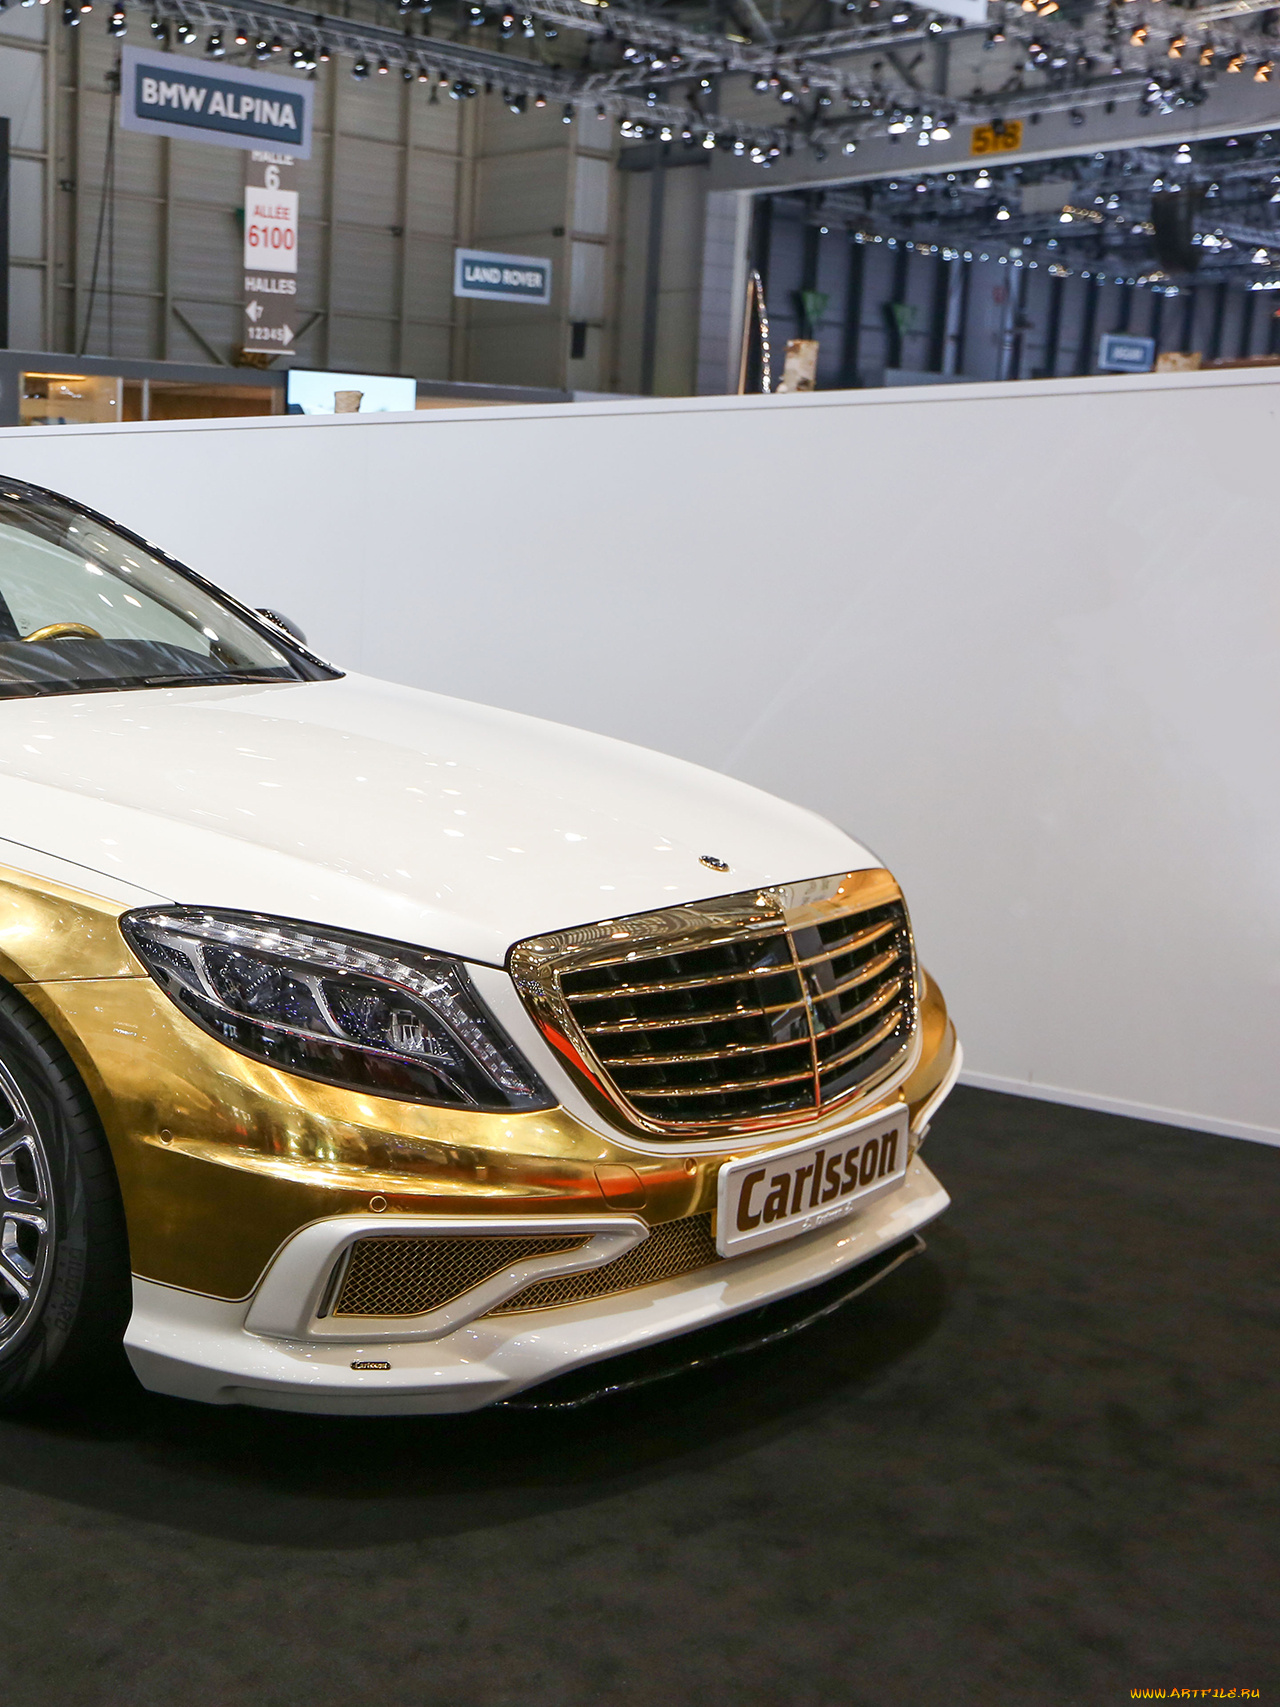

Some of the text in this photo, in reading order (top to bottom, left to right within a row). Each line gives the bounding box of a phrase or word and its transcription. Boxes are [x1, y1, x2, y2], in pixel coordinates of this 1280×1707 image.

[141, 77, 297, 130] BMW ALPINA
[264, 165, 280, 190] 6
[249, 225, 294, 249] 6100
[244, 276, 297, 295] HALLES
[465, 265, 543, 288] LAND ROVER
[736, 1129, 898, 1232] Carlsson
